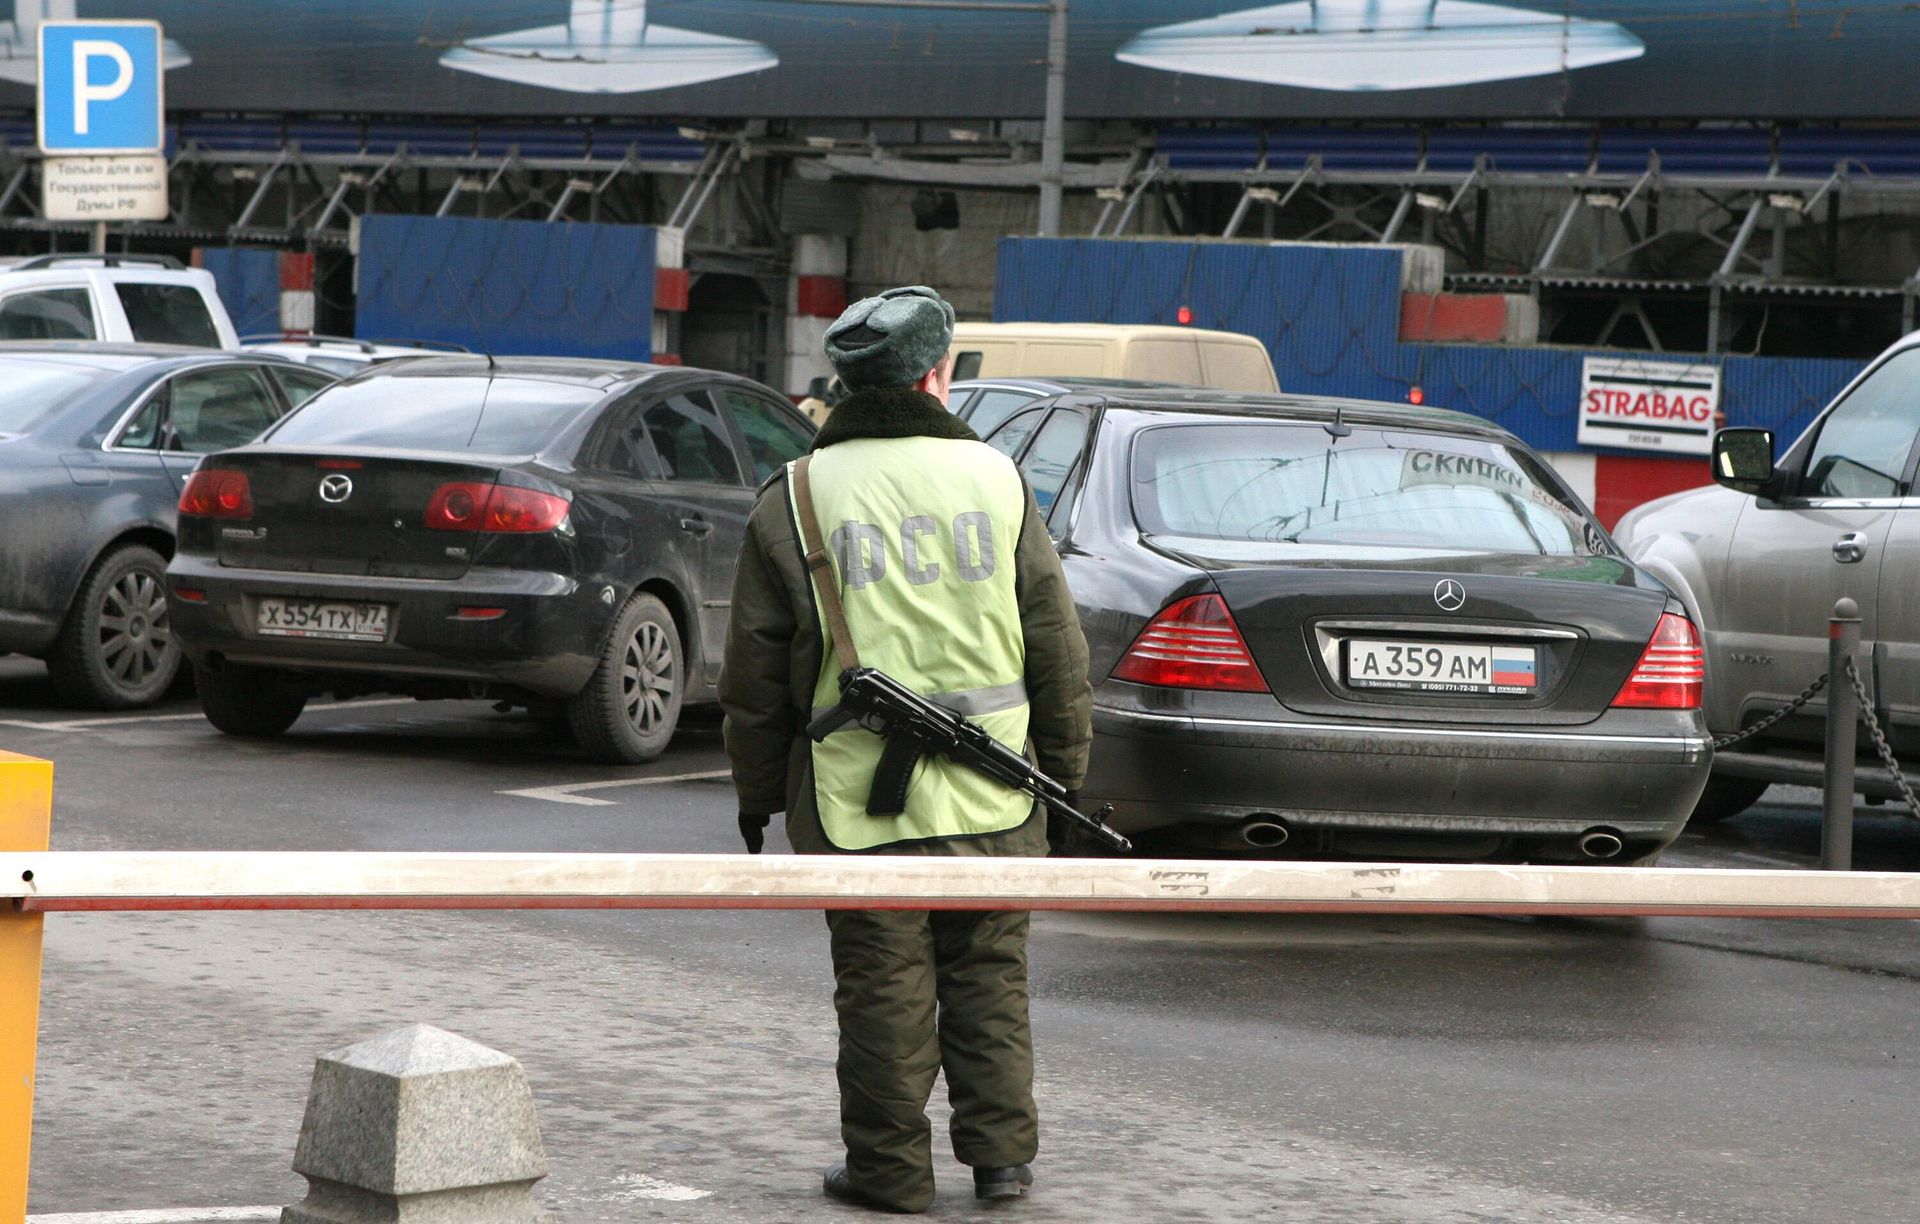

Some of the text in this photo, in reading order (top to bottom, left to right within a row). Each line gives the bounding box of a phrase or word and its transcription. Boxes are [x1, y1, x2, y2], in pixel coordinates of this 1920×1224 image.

[73, 40, 134, 135] P
[58, 164, 103, 175] Только
[106, 165, 130, 176] для
[49, 182, 161, 195] Государственной
[76, 199, 137, 213] Думы РФ
[1586, 388, 1711, 422] STRABAG
[830, 511, 996, 591] ФСО
